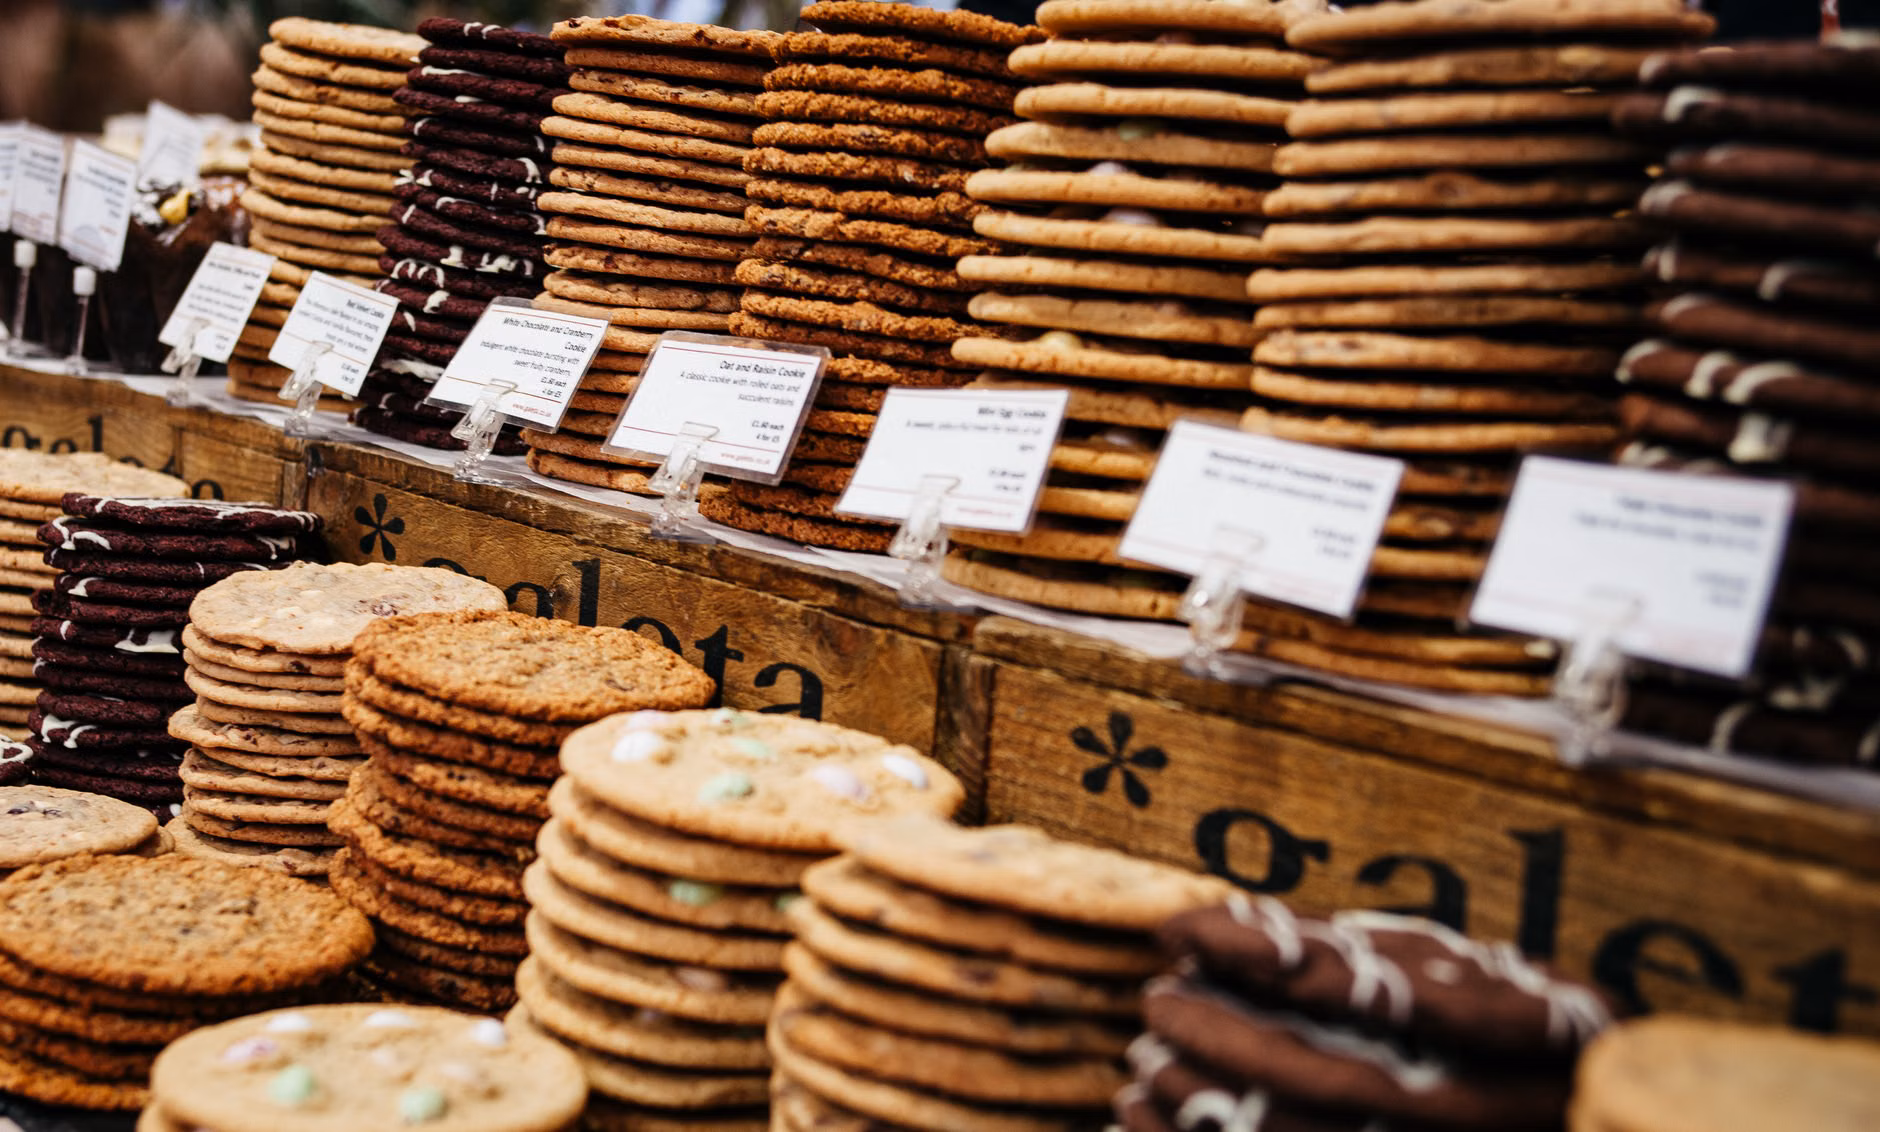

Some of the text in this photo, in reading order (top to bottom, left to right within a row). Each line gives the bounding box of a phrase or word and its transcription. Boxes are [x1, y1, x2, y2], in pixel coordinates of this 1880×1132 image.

[504, 316, 594, 340] White Chocolate and Cranberry
[518, 348, 543, 358] chocolate
[564, 341, 587, 353] Cookie
[720, 360, 806, 378] Oat and Raisin Cookie
[686, 372, 707, 382] classic
[708, 375, 731, 385] cookie
[732, 378, 749, 386] with
[749, 380, 769, 389] rolled
[770, 382, 786, 391] oats
[786, 384, 801, 393] and
[737, 393, 772, 405] succulent
